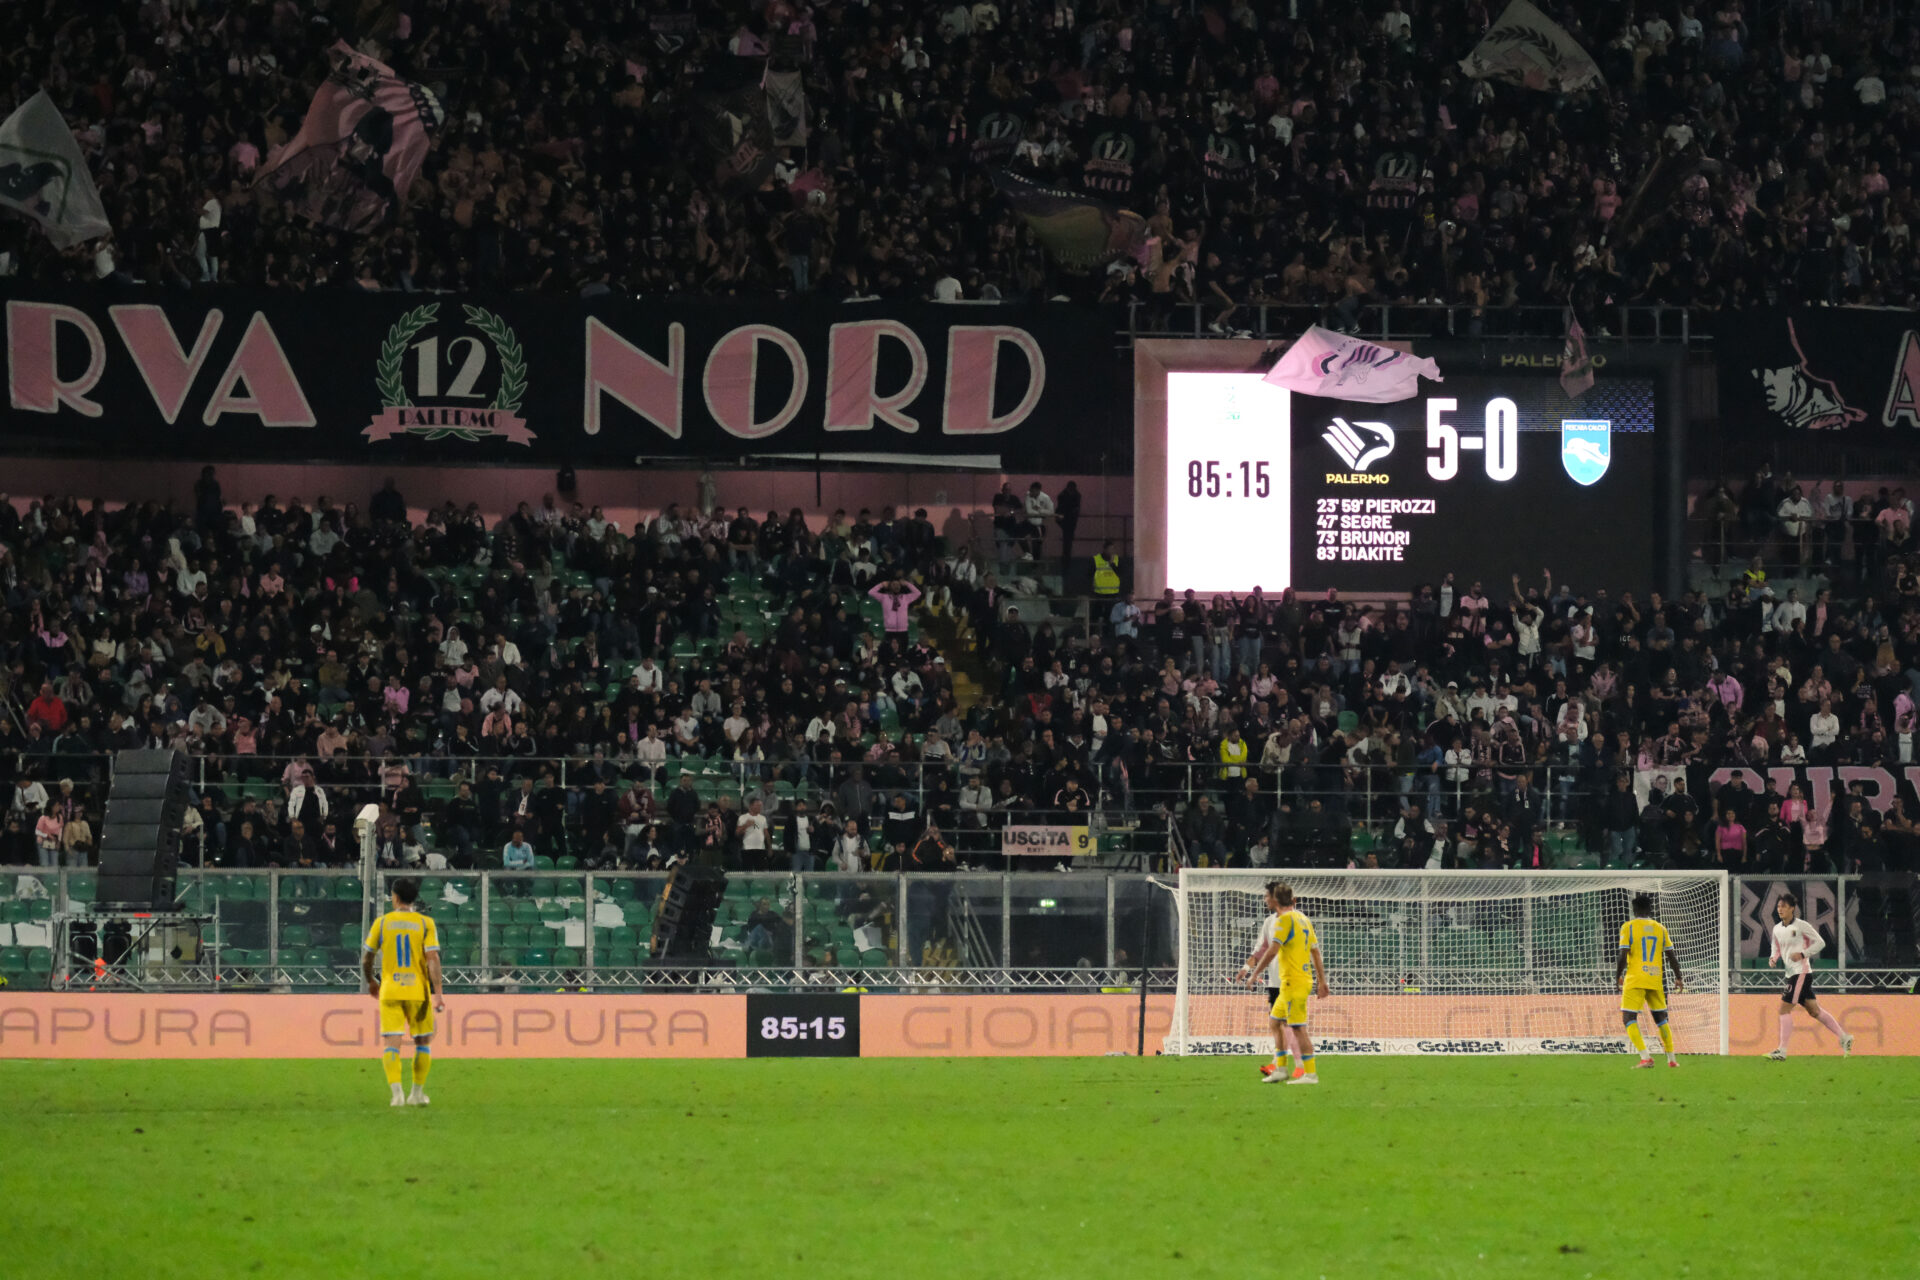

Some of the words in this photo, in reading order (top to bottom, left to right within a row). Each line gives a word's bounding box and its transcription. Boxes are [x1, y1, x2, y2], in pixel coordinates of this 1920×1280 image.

[410, 335, 487, 399] 12
[1501, 353, 1606, 367] PALEO
[584, 315, 1046, 440] NORD
[398, 408, 502, 428] PALERMO
[1426, 397, 1518, 481] 5-0
[1188, 460, 1270, 498] 85:15
[1326, 473, 1389, 485] PALERMO
[1316, 498, 1339, 513] 23'
[1341, 498, 1364, 513] 59'
[1365, 498, 1436, 514] PIEROZZI
[1316, 514, 1338, 529] 47'
[1340, 514, 1393, 529] SEGRE
[1316, 530, 1338, 545] 73'
[1340, 530, 1410, 545] BRUNORI
[1316, 546, 1339, 561] 83'
[1341, 544, 1404, 561] DIAKITÉ
[1003, 831, 1070, 846] USCITA
[1078, 834, 1089, 848] 9
[396, 933, 411, 968] 11
[1641, 935, 1658, 962] 17
[320, 1009, 709, 1047] GIIAPURA
[760, 1016, 846, 1040] 85:15
[1417, 1039, 1506, 1054] GoldBet
